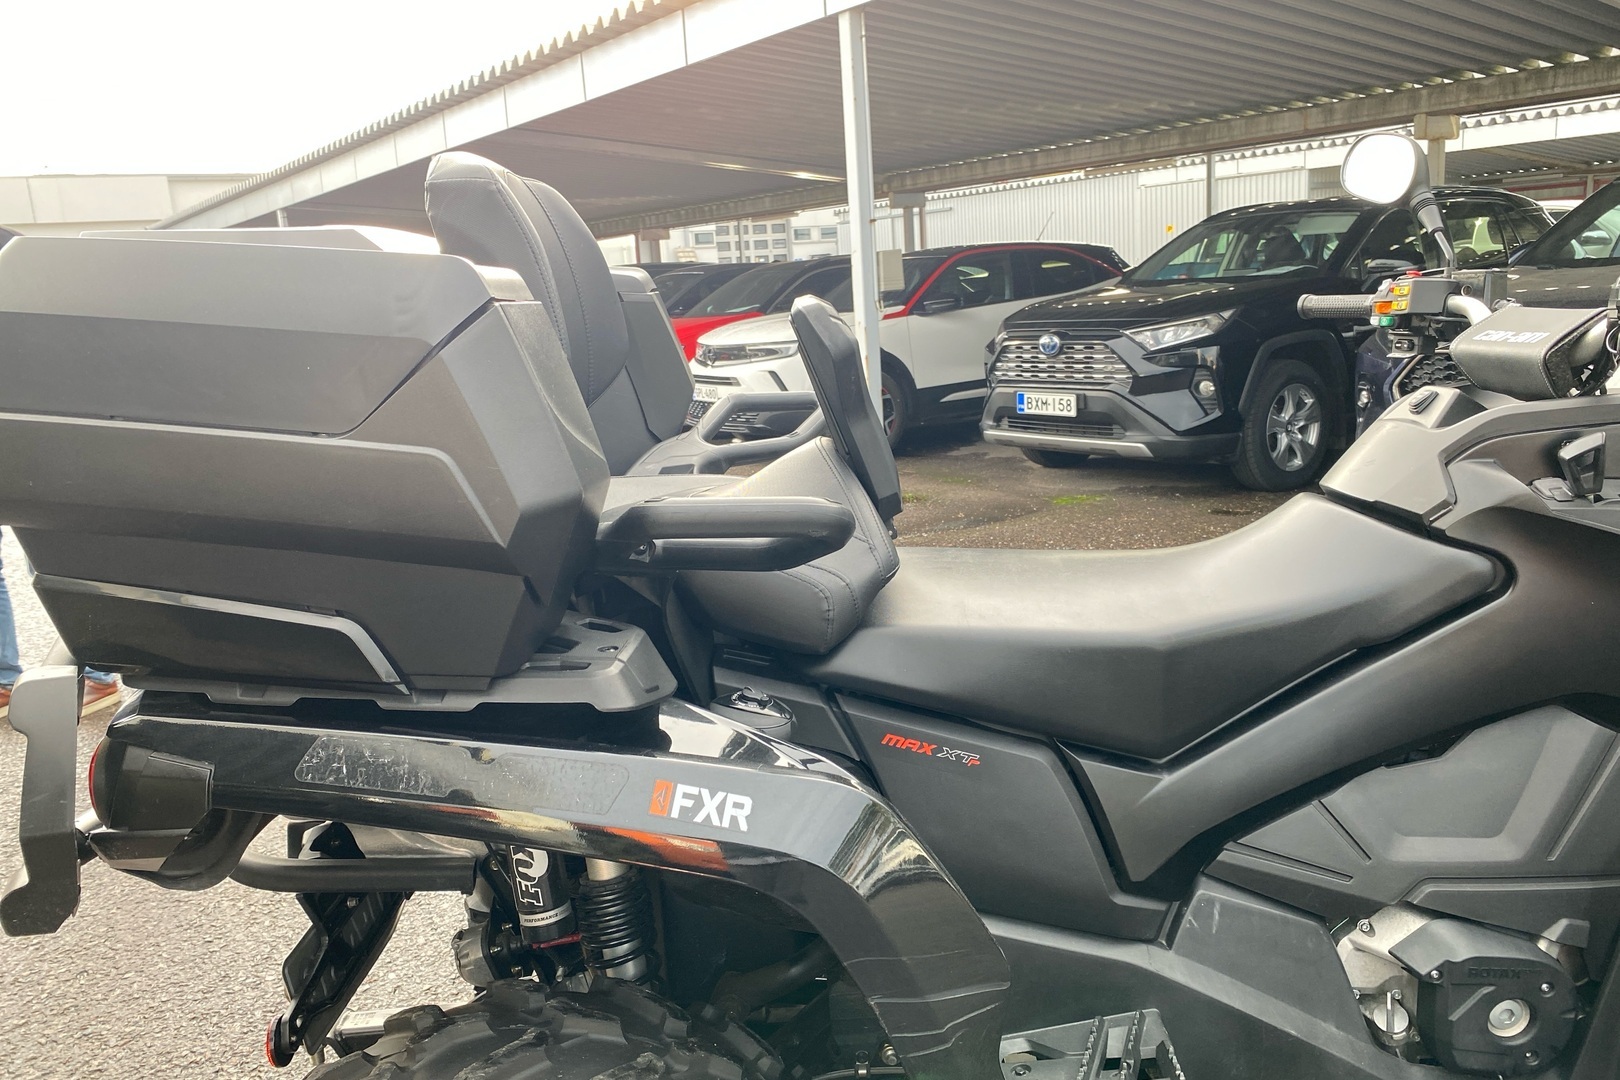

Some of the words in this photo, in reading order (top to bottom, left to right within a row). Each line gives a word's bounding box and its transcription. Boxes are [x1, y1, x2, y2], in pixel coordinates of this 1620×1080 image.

[1026, 396, 1073, 412] BXM-158
[881, 733, 938, 756] MAX
[670, 783, 753, 832] FXR
[523, 911, 559, 923] PERFORMANCE
[1467, 967, 1521, 979] ROTAX
